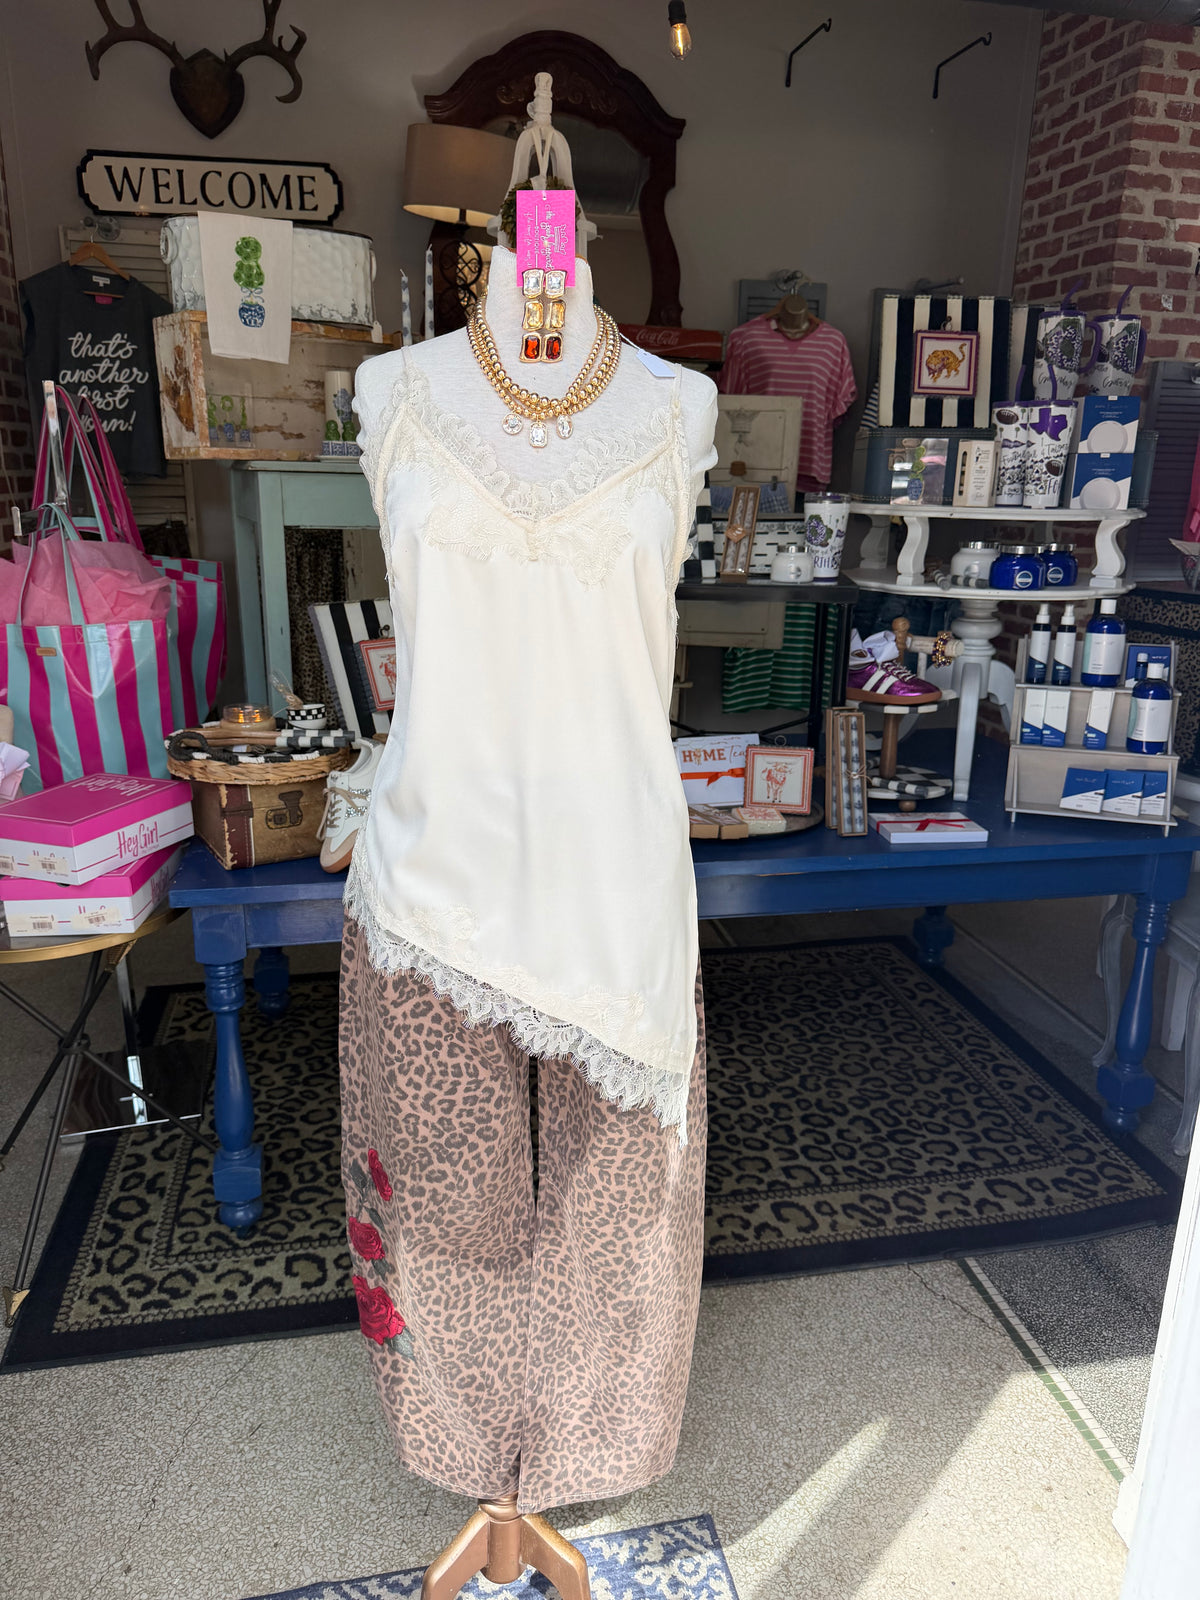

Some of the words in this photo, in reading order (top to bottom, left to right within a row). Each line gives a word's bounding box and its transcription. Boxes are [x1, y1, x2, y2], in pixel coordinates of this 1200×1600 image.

[104, 165, 319, 211] WELCOME
[68, 332, 138, 358] that's
[59, 358, 149, 384] another
[77, 384, 135, 411] rst
